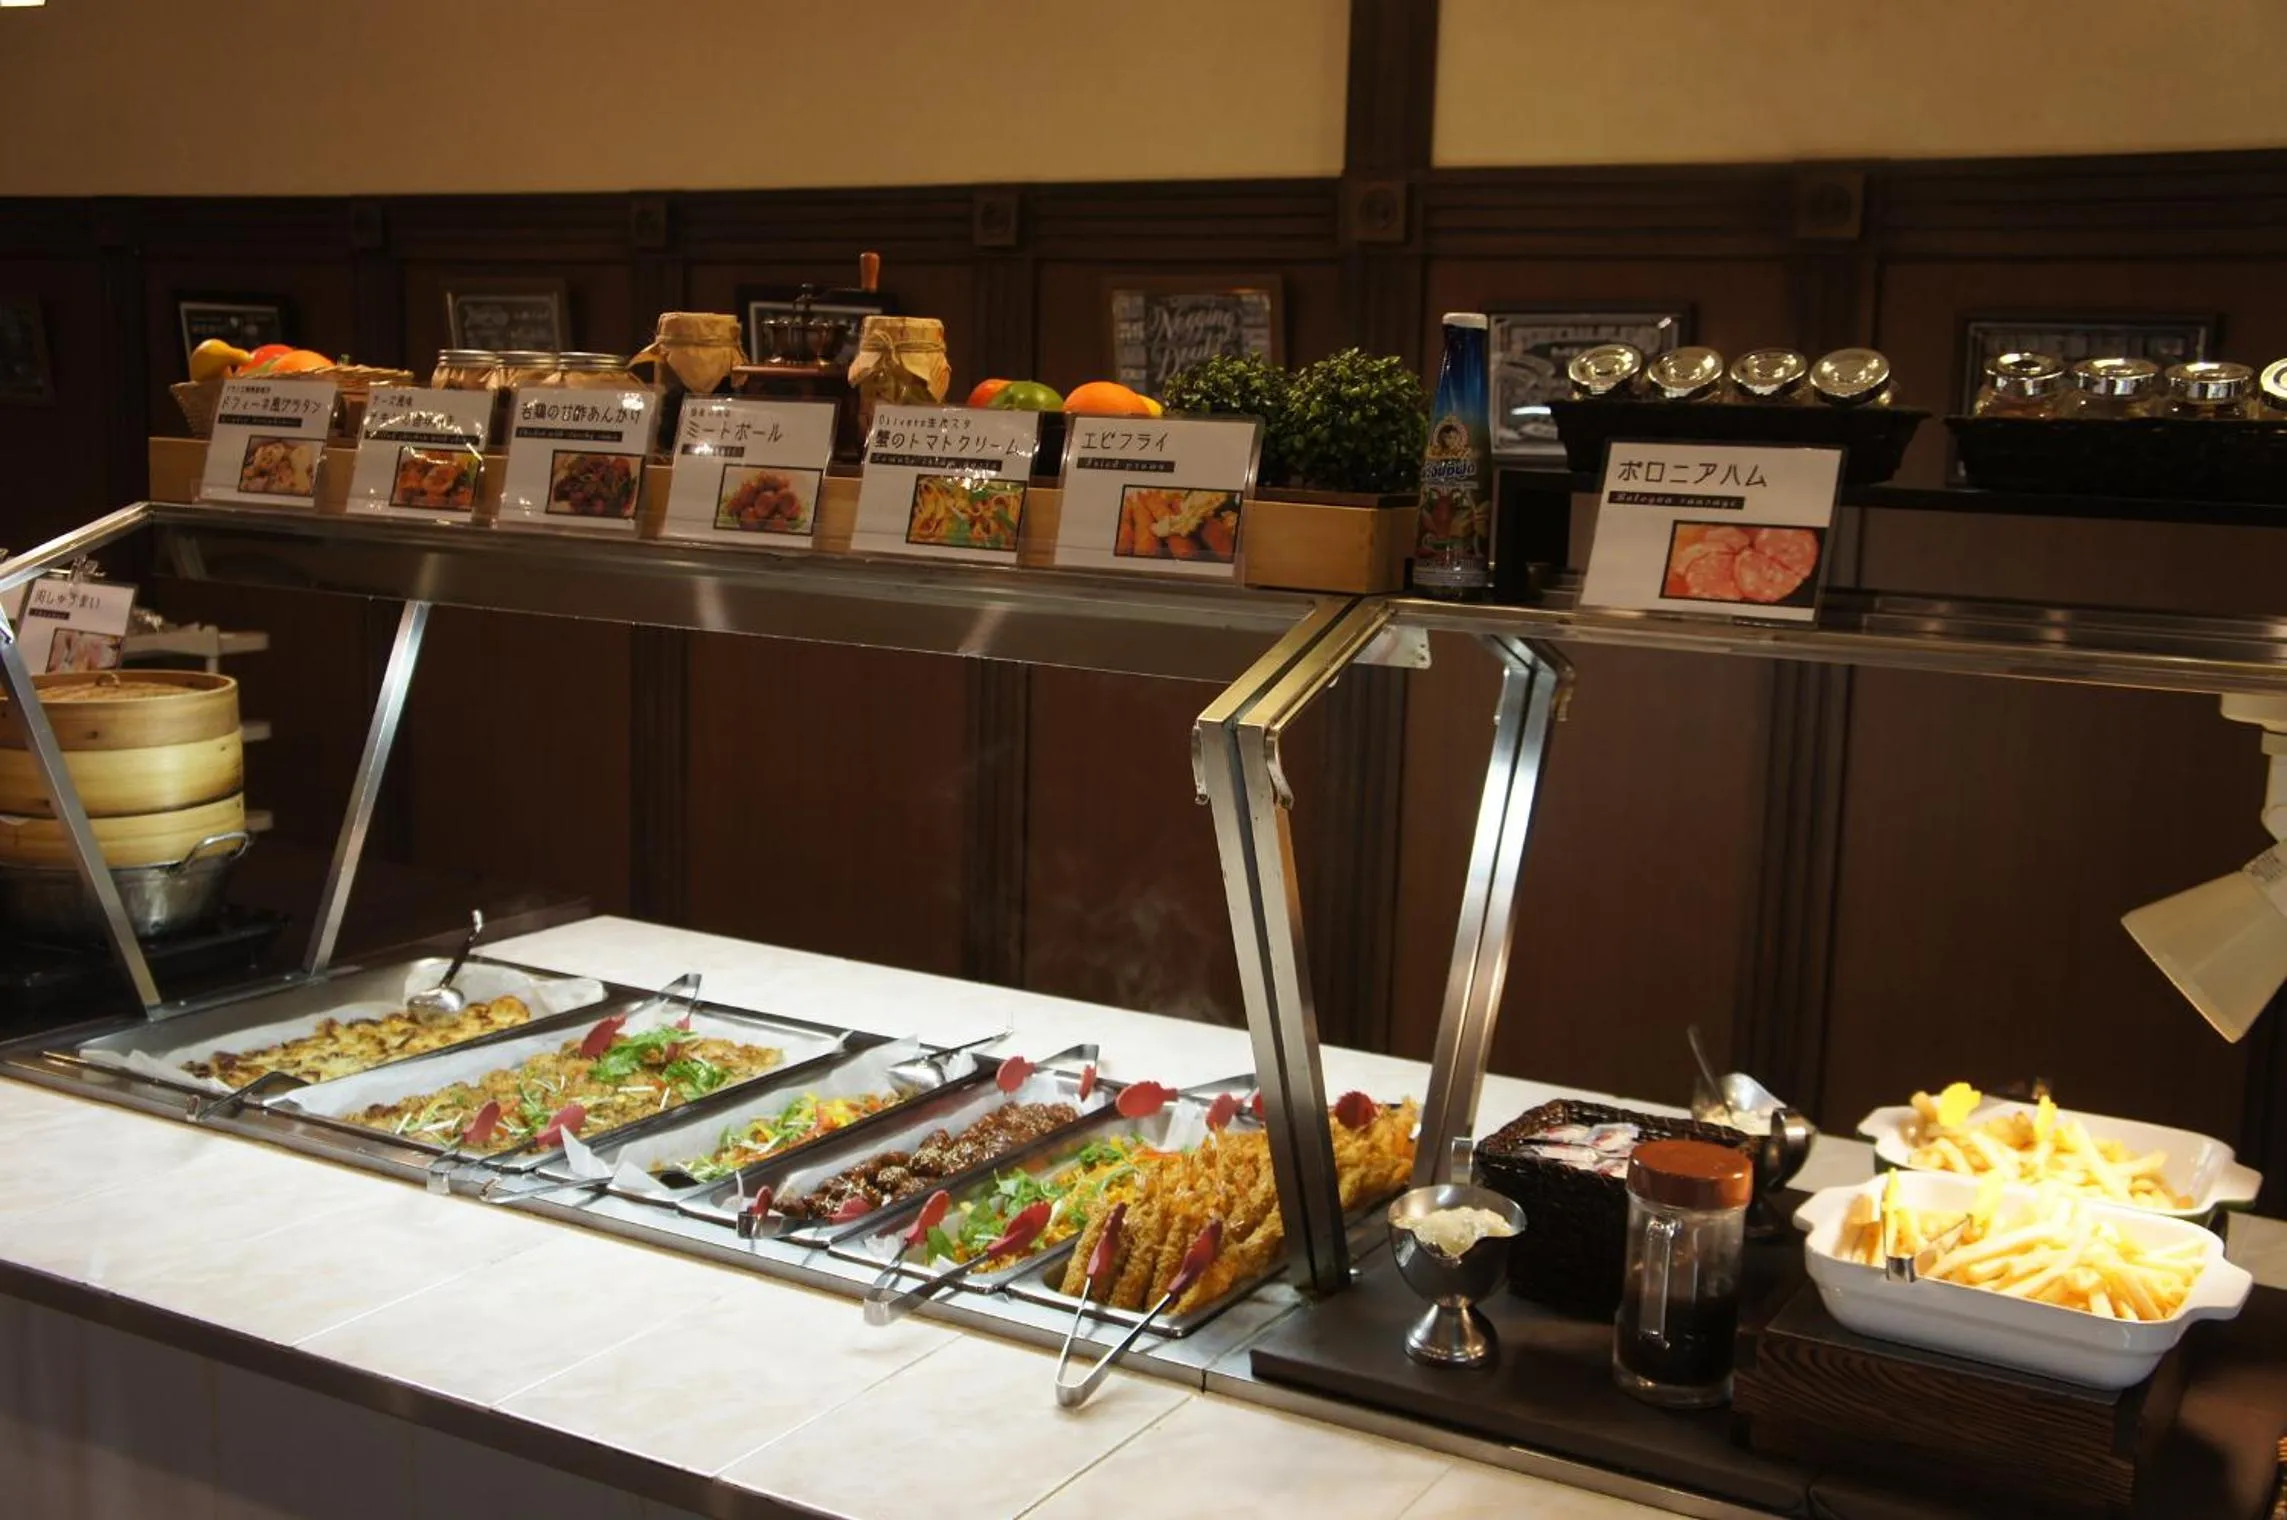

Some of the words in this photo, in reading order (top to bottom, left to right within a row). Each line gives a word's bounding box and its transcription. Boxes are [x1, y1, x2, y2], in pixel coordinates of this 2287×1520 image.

[521, 401, 641, 424] 若鶏の甘酢あんかけ
[686, 421, 784, 442] ミートボール
[1081, 431, 1169, 452] エビフライ
[875, 429, 1021, 456] 蟹のトマトクリーム
[1614, 492, 1673, 506] Bologna
